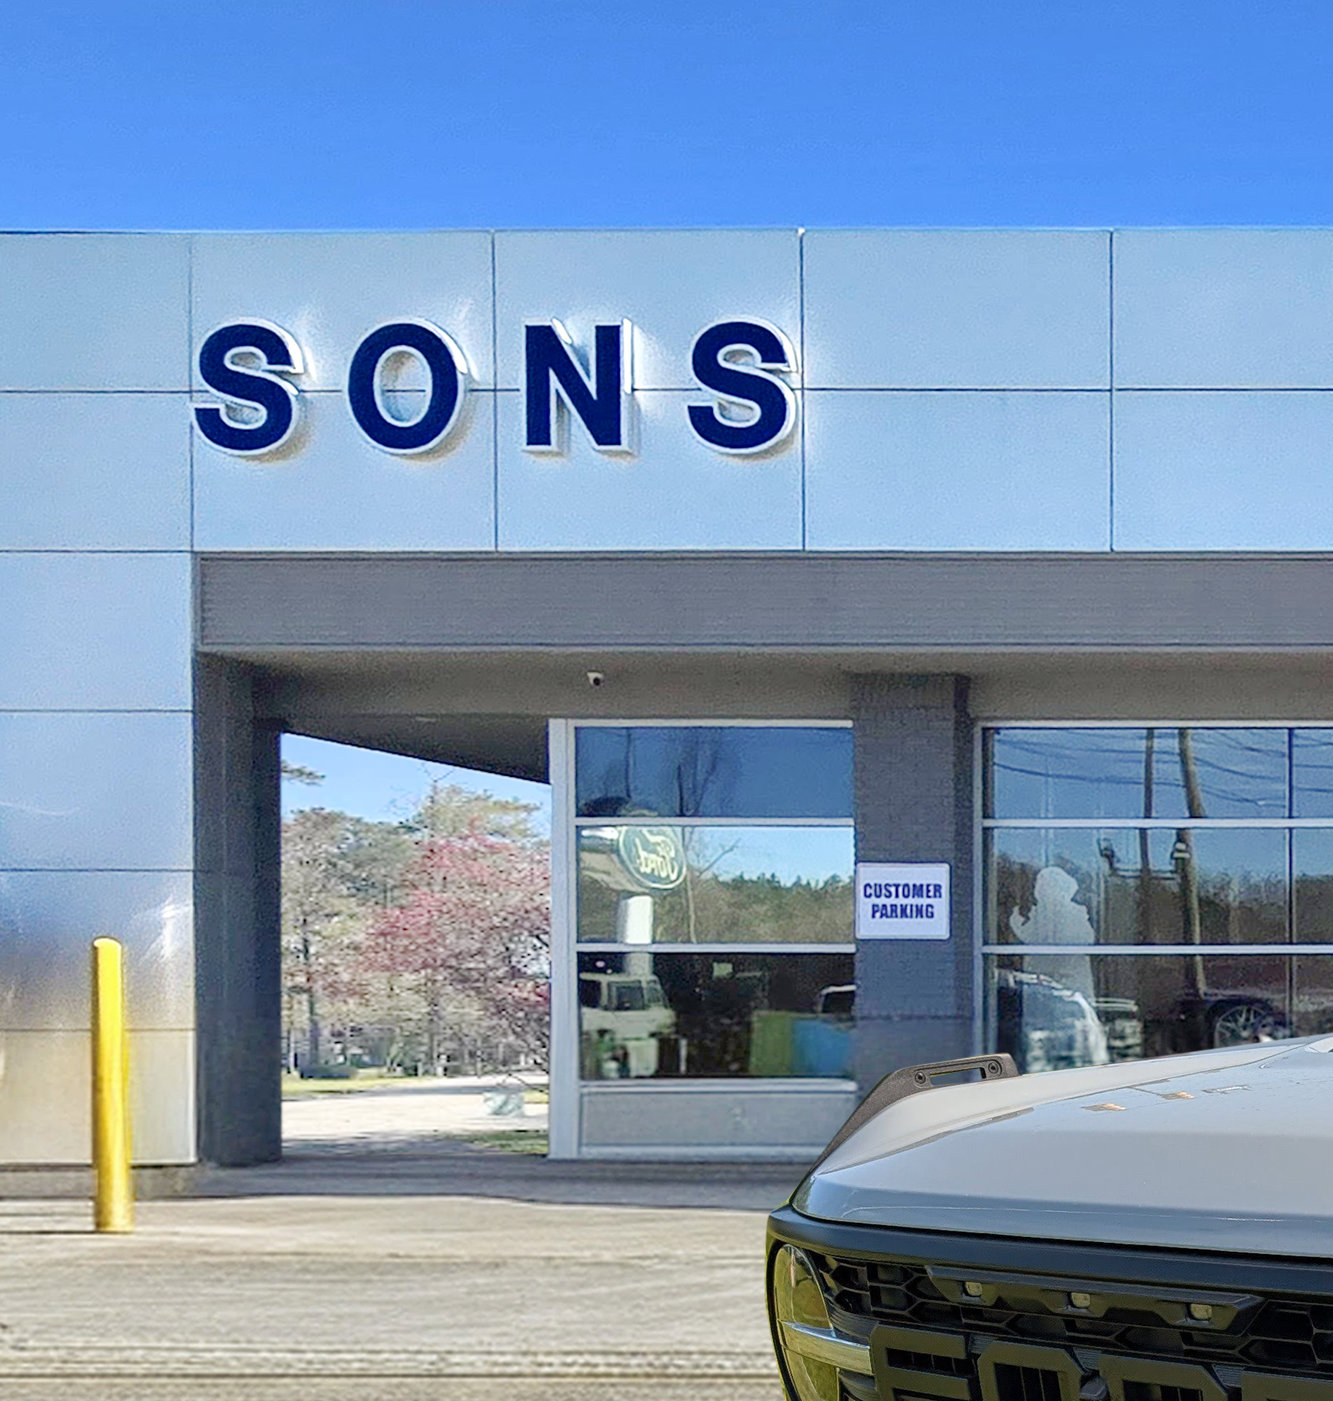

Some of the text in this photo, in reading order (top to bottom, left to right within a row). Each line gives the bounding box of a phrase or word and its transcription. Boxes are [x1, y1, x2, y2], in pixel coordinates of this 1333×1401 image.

[192, 319, 802, 454] SONS
[863, 883, 943, 899] CUSTOMER
[871, 904, 935, 919] PARKING
